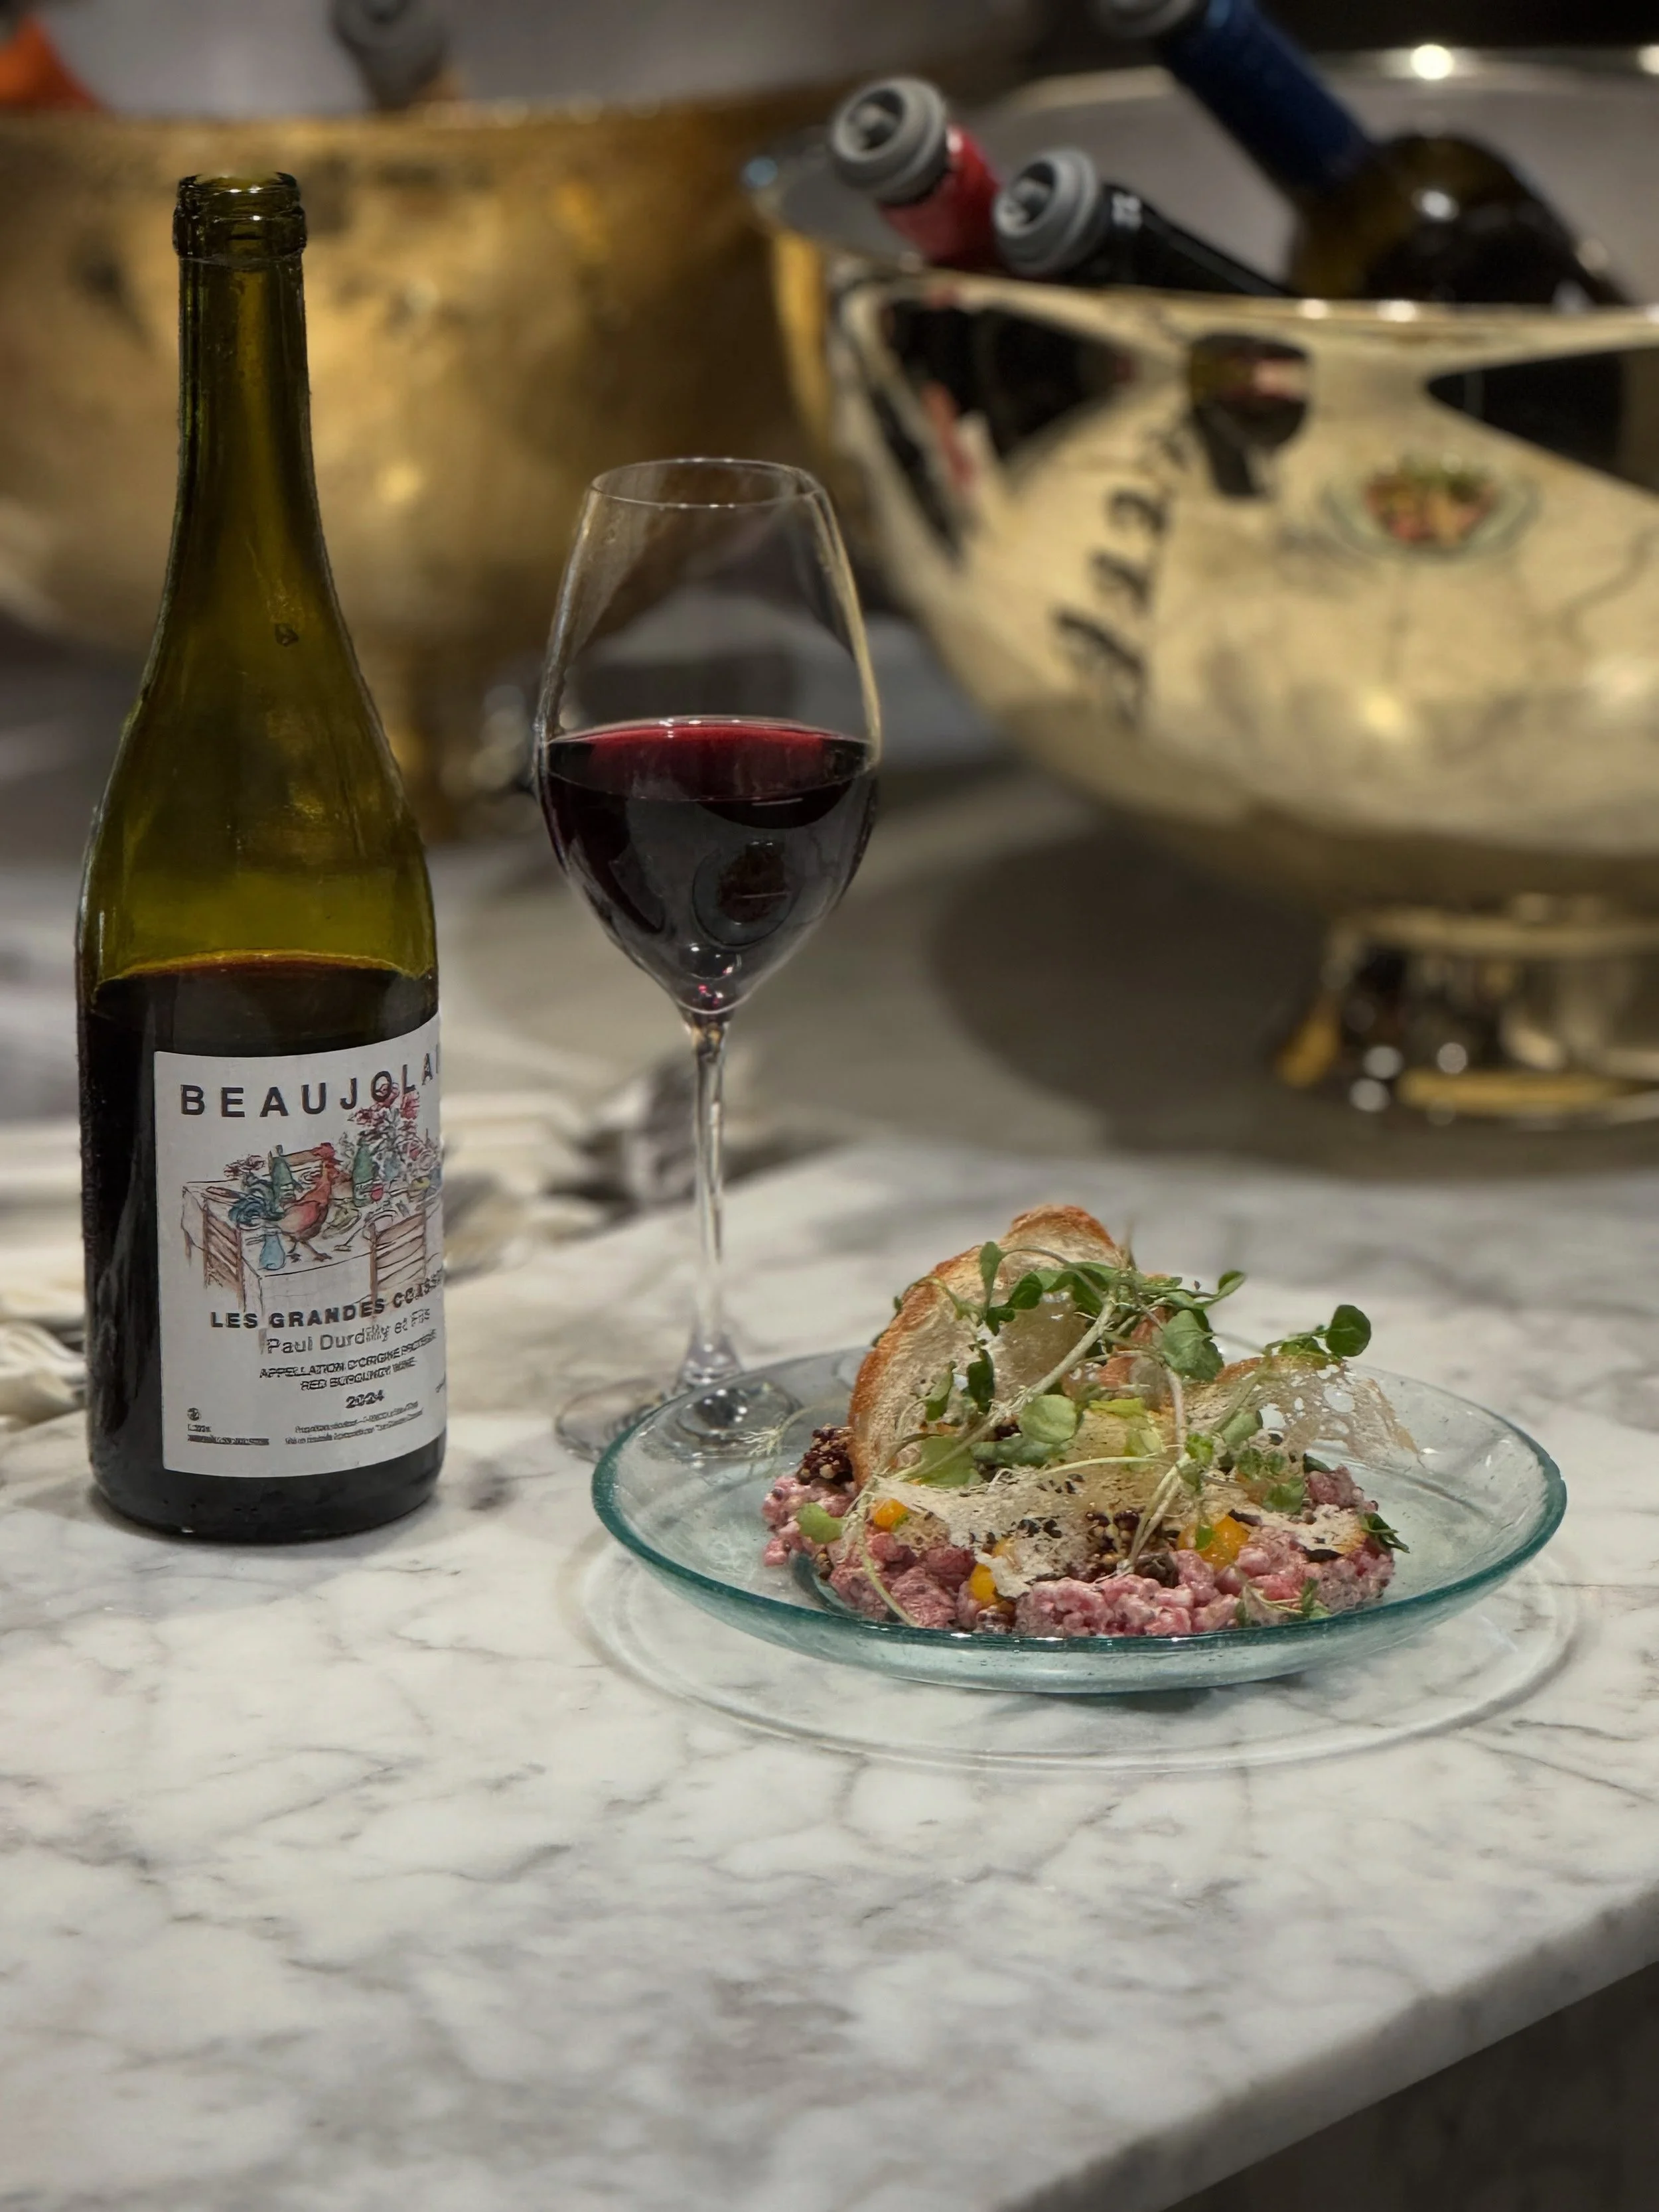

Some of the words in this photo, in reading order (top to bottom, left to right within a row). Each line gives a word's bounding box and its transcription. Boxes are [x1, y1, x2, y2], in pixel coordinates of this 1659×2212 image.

[210, 1311, 258, 1329] LES
[268, 1297, 386, 1329] GRANDES
[266, 1336, 314, 1355] Paul
